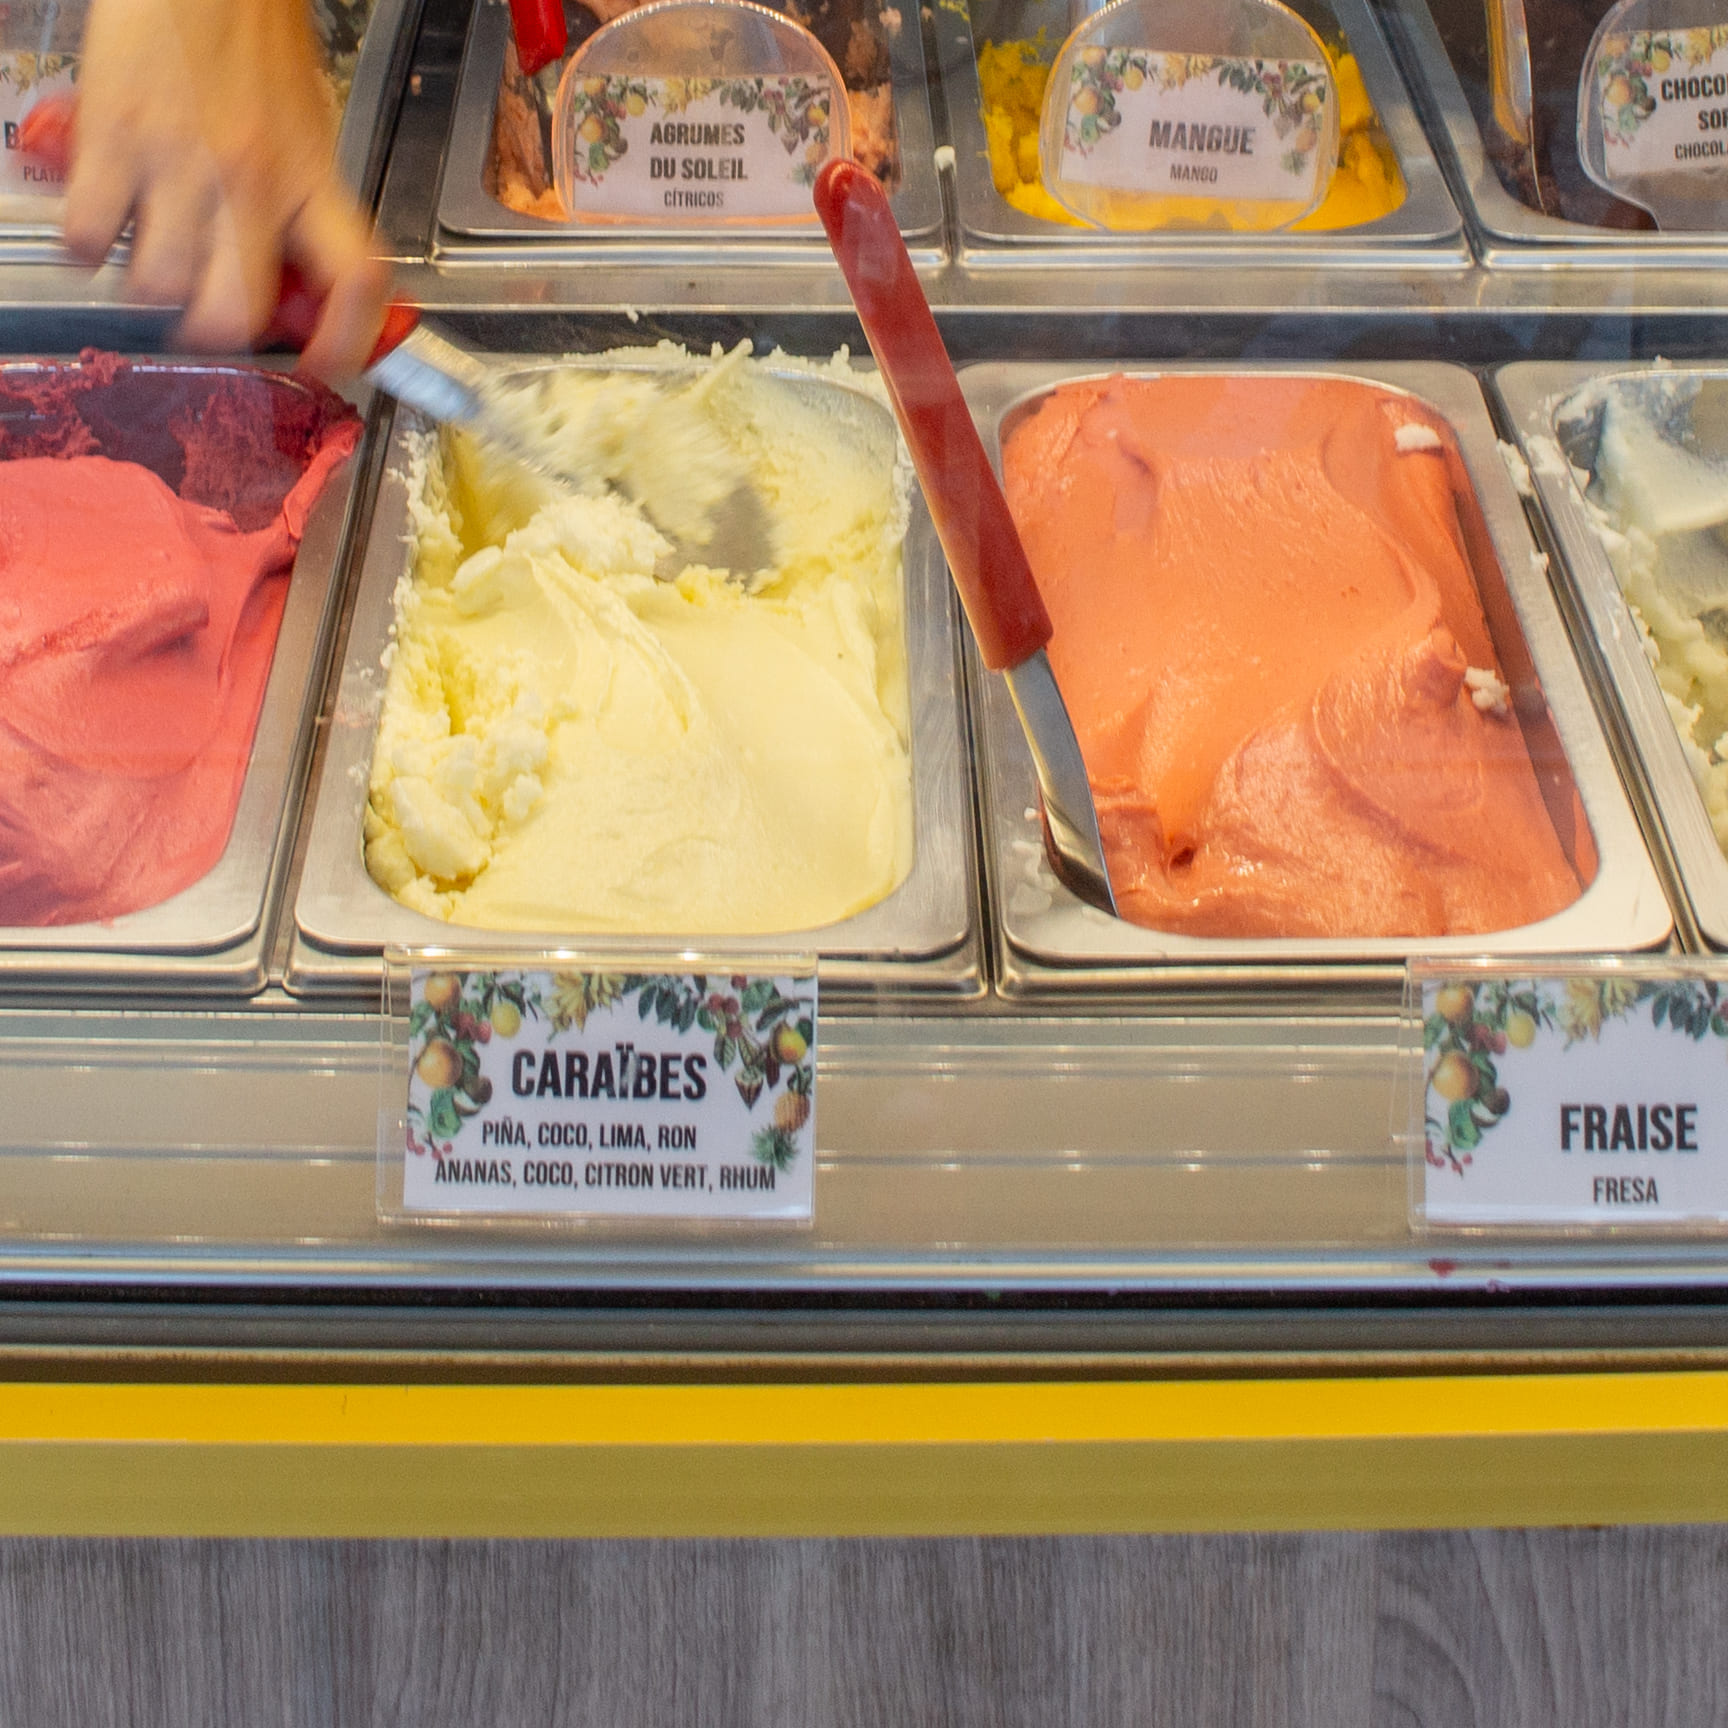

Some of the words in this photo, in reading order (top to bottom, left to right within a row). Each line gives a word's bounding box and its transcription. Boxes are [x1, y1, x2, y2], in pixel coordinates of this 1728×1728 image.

[650, 122, 746, 145] AGRUMES
[1149, 120, 1256, 154] MANGUE
[650, 157, 676, 179] DU
[681, 157, 749, 180] SOLEIL
[1170, 163, 1219, 184] MANGO
[664, 187, 724, 208] CÍTRICOS
[512, 1042, 708, 1100] CARAÏBES
[482, 1116, 531, 1150] PIÑA,
[537, 1121, 593, 1150] COCO,
[599, 1122, 652, 1152] LIMA,
[658, 1125, 698, 1149] RON
[1559, 1103, 1699, 1152] FRAISE
[434, 1159, 517, 1188] ANANAS,
[523, 1161, 578, 1189] COCO,
[585, 1163, 655, 1189] CITRON
[660, 1164, 714, 1193] VERT,
[719, 1166, 776, 1191] RHUM
[1593, 1176, 1659, 1204] FRESA
